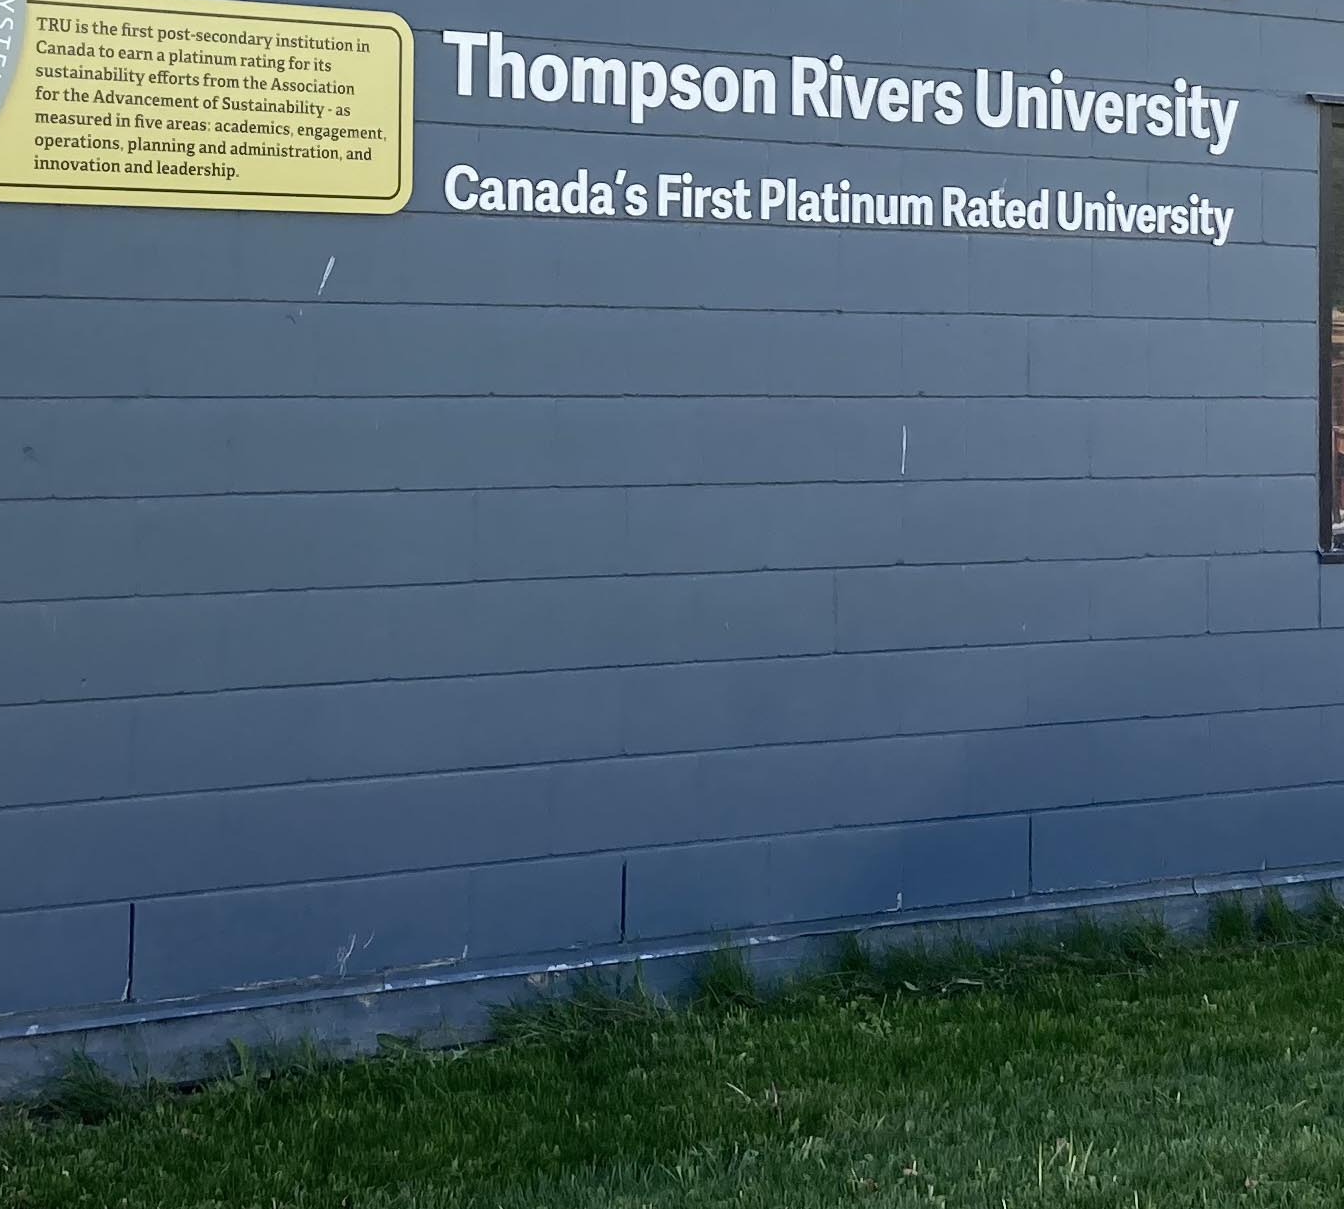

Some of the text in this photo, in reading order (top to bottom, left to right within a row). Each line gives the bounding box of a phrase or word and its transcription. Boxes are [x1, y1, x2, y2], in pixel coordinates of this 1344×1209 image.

[36, 17, 371, 53] TRU is the first post-secondary institution in
[36, 40, 332, 73] Canada to earn a platinum rating for its
[36, 65, 354, 95] sustainability efforts from the Association
[442, 30, 1239, 155] Thompson Rivers University
[35, 86, 60, 101] for
[62, 88, 89, 102] the
[93, 90, 199, 108] Advancement
[203, 96, 220, 109] of
[222, 97, 325, 119] Sustainability
[336, 106, 351, 116] as
[35, 112, 386, 141] measured in five areas: academics, engagement,
[35, 134, 372, 161] operations, planning and administration, and
[34, 155, 239, 181] innovation and leadership.
[444, 164, 1234, 246] Canada's First Platinum Rated University
